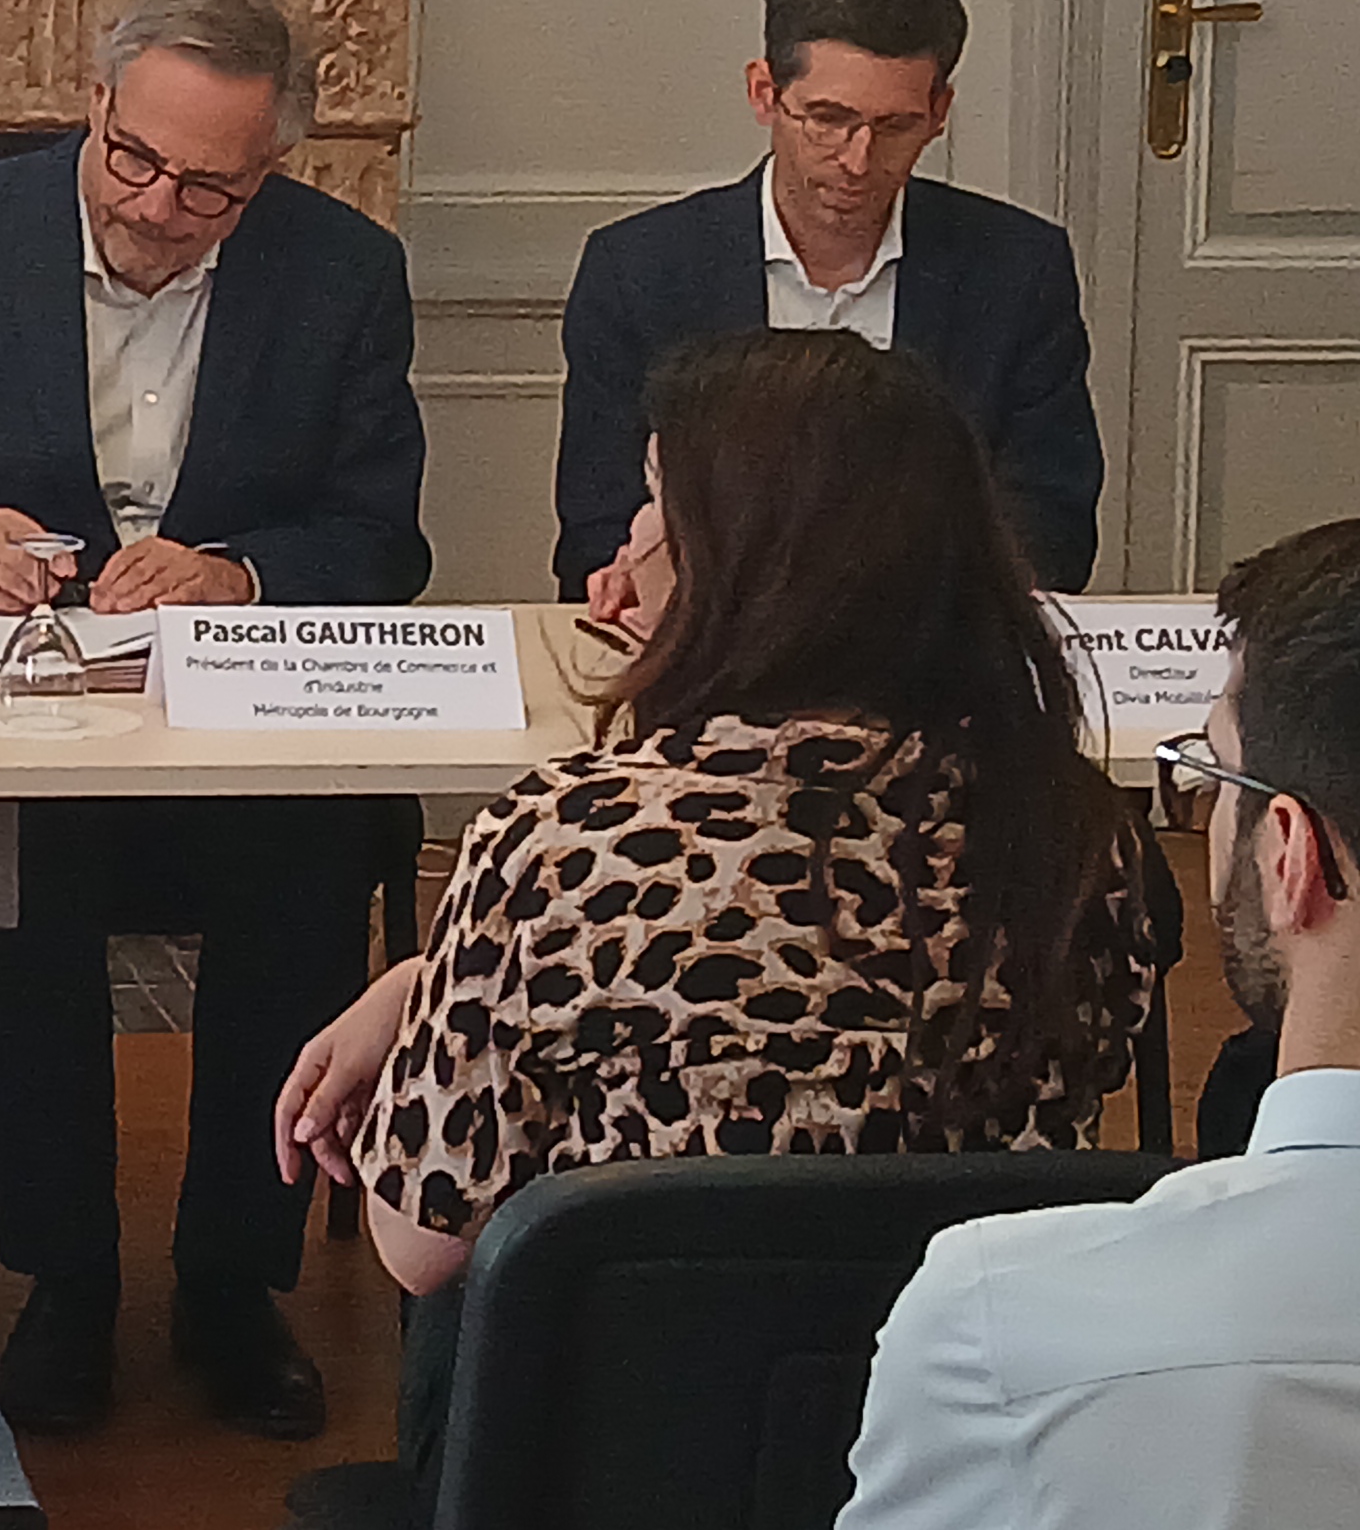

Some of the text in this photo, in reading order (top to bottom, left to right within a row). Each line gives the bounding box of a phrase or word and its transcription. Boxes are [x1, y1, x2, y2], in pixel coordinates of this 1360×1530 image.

[194, 620, 485, 647] Pascal GAUTHERON
[1065, 628, 1232, 652] rent CALVA
